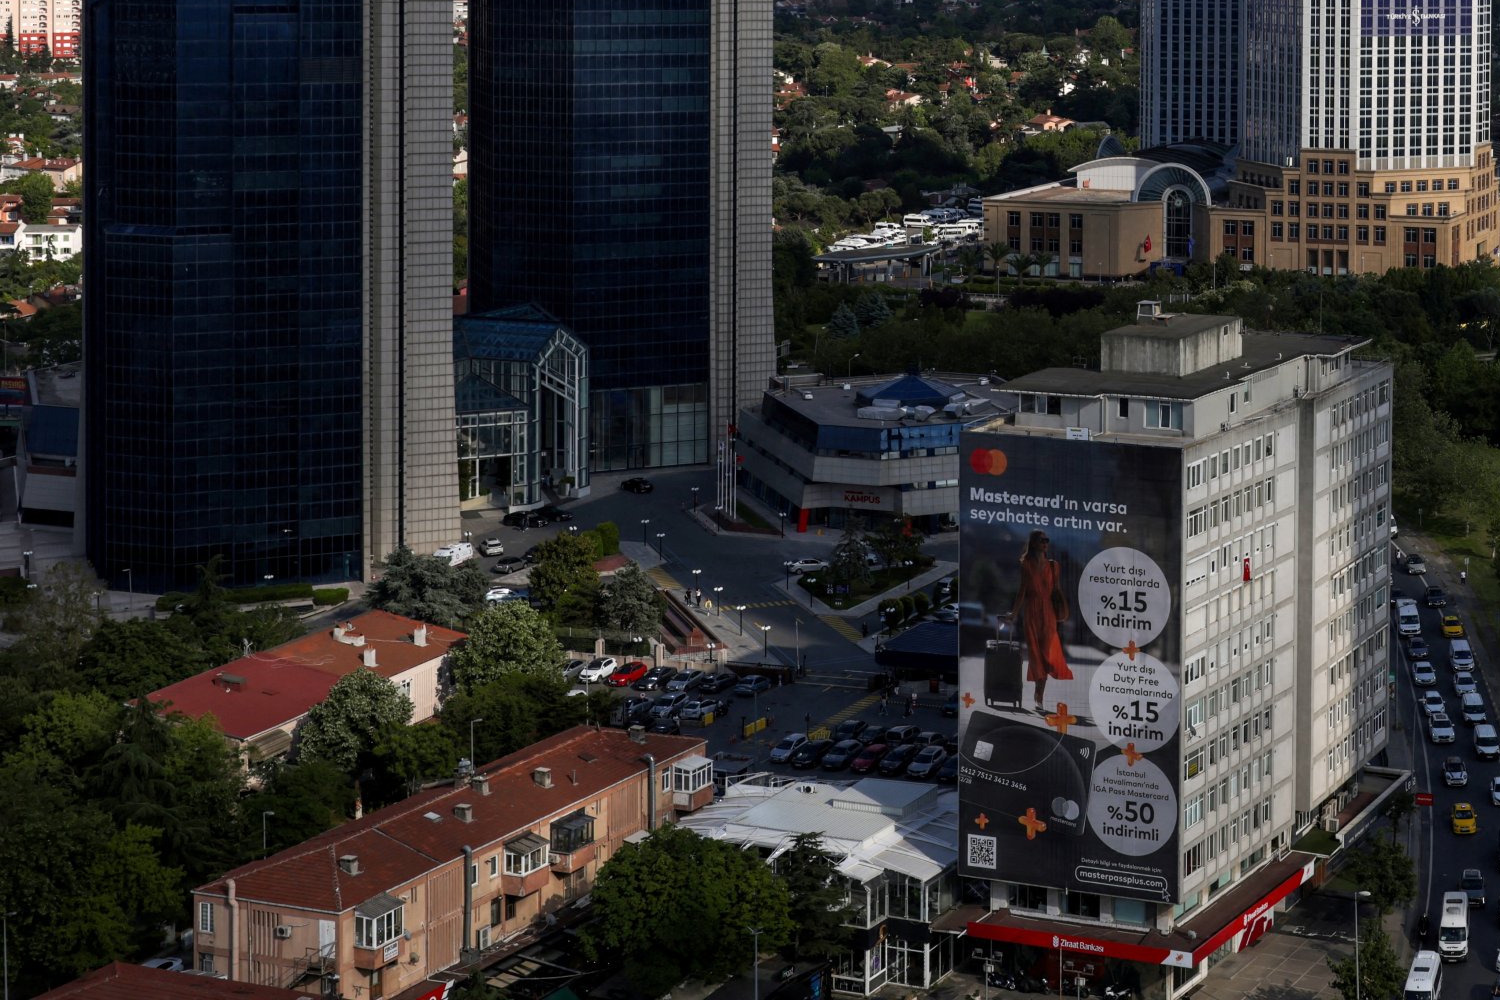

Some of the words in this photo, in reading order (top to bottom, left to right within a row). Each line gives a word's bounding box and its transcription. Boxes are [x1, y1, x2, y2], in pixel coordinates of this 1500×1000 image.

[970, 487, 1078, 511] Mastercard'ın
[1083, 500, 1127, 515] varsa
[970, 508, 1050, 524] seyahatte
[1053, 515, 1092, 530] artın
[1096, 520, 1128, 533] var.
[1103, 563, 1126, 574] Yurt
[1128, 566, 1146, 577] dışı
[1089, 575, 1160, 589] restoranlarda
[1100, 590, 1147, 613] %15
[1096, 612, 1152, 631] indirim
[1117, 662, 1137, 673] Yurt
[1140, 665, 1156, 675] dışı
[1113, 673, 1136, 685] Duty
[1138, 676, 1159, 687] Free
[1099, 683, 1173, 699] harcamalarında
[1112, 700, 1159, 723] %15
[1108, 721, 1164, 741] indirim
[960, 766, 976, 776] 5412
[977, 771, 993, 781] 7512
[993, 776, 1010, 786] 3412
[1010, 781, 1027, 791] 3456
[1116, 767, 1146, 779] İstanbul
[1109, 786, 1126, 796] Pass
[1127, 789, 1169, 801] Mastercard
[1107, 800, 1155, 824] %50
[1103, 822, 1159, 841] indirimli
[1079, 871, 1163, 887] masterpassplus.com
[1060, 938, 1080, 949] Ziraat
[1079, 941, 1104, 953] Bankası
